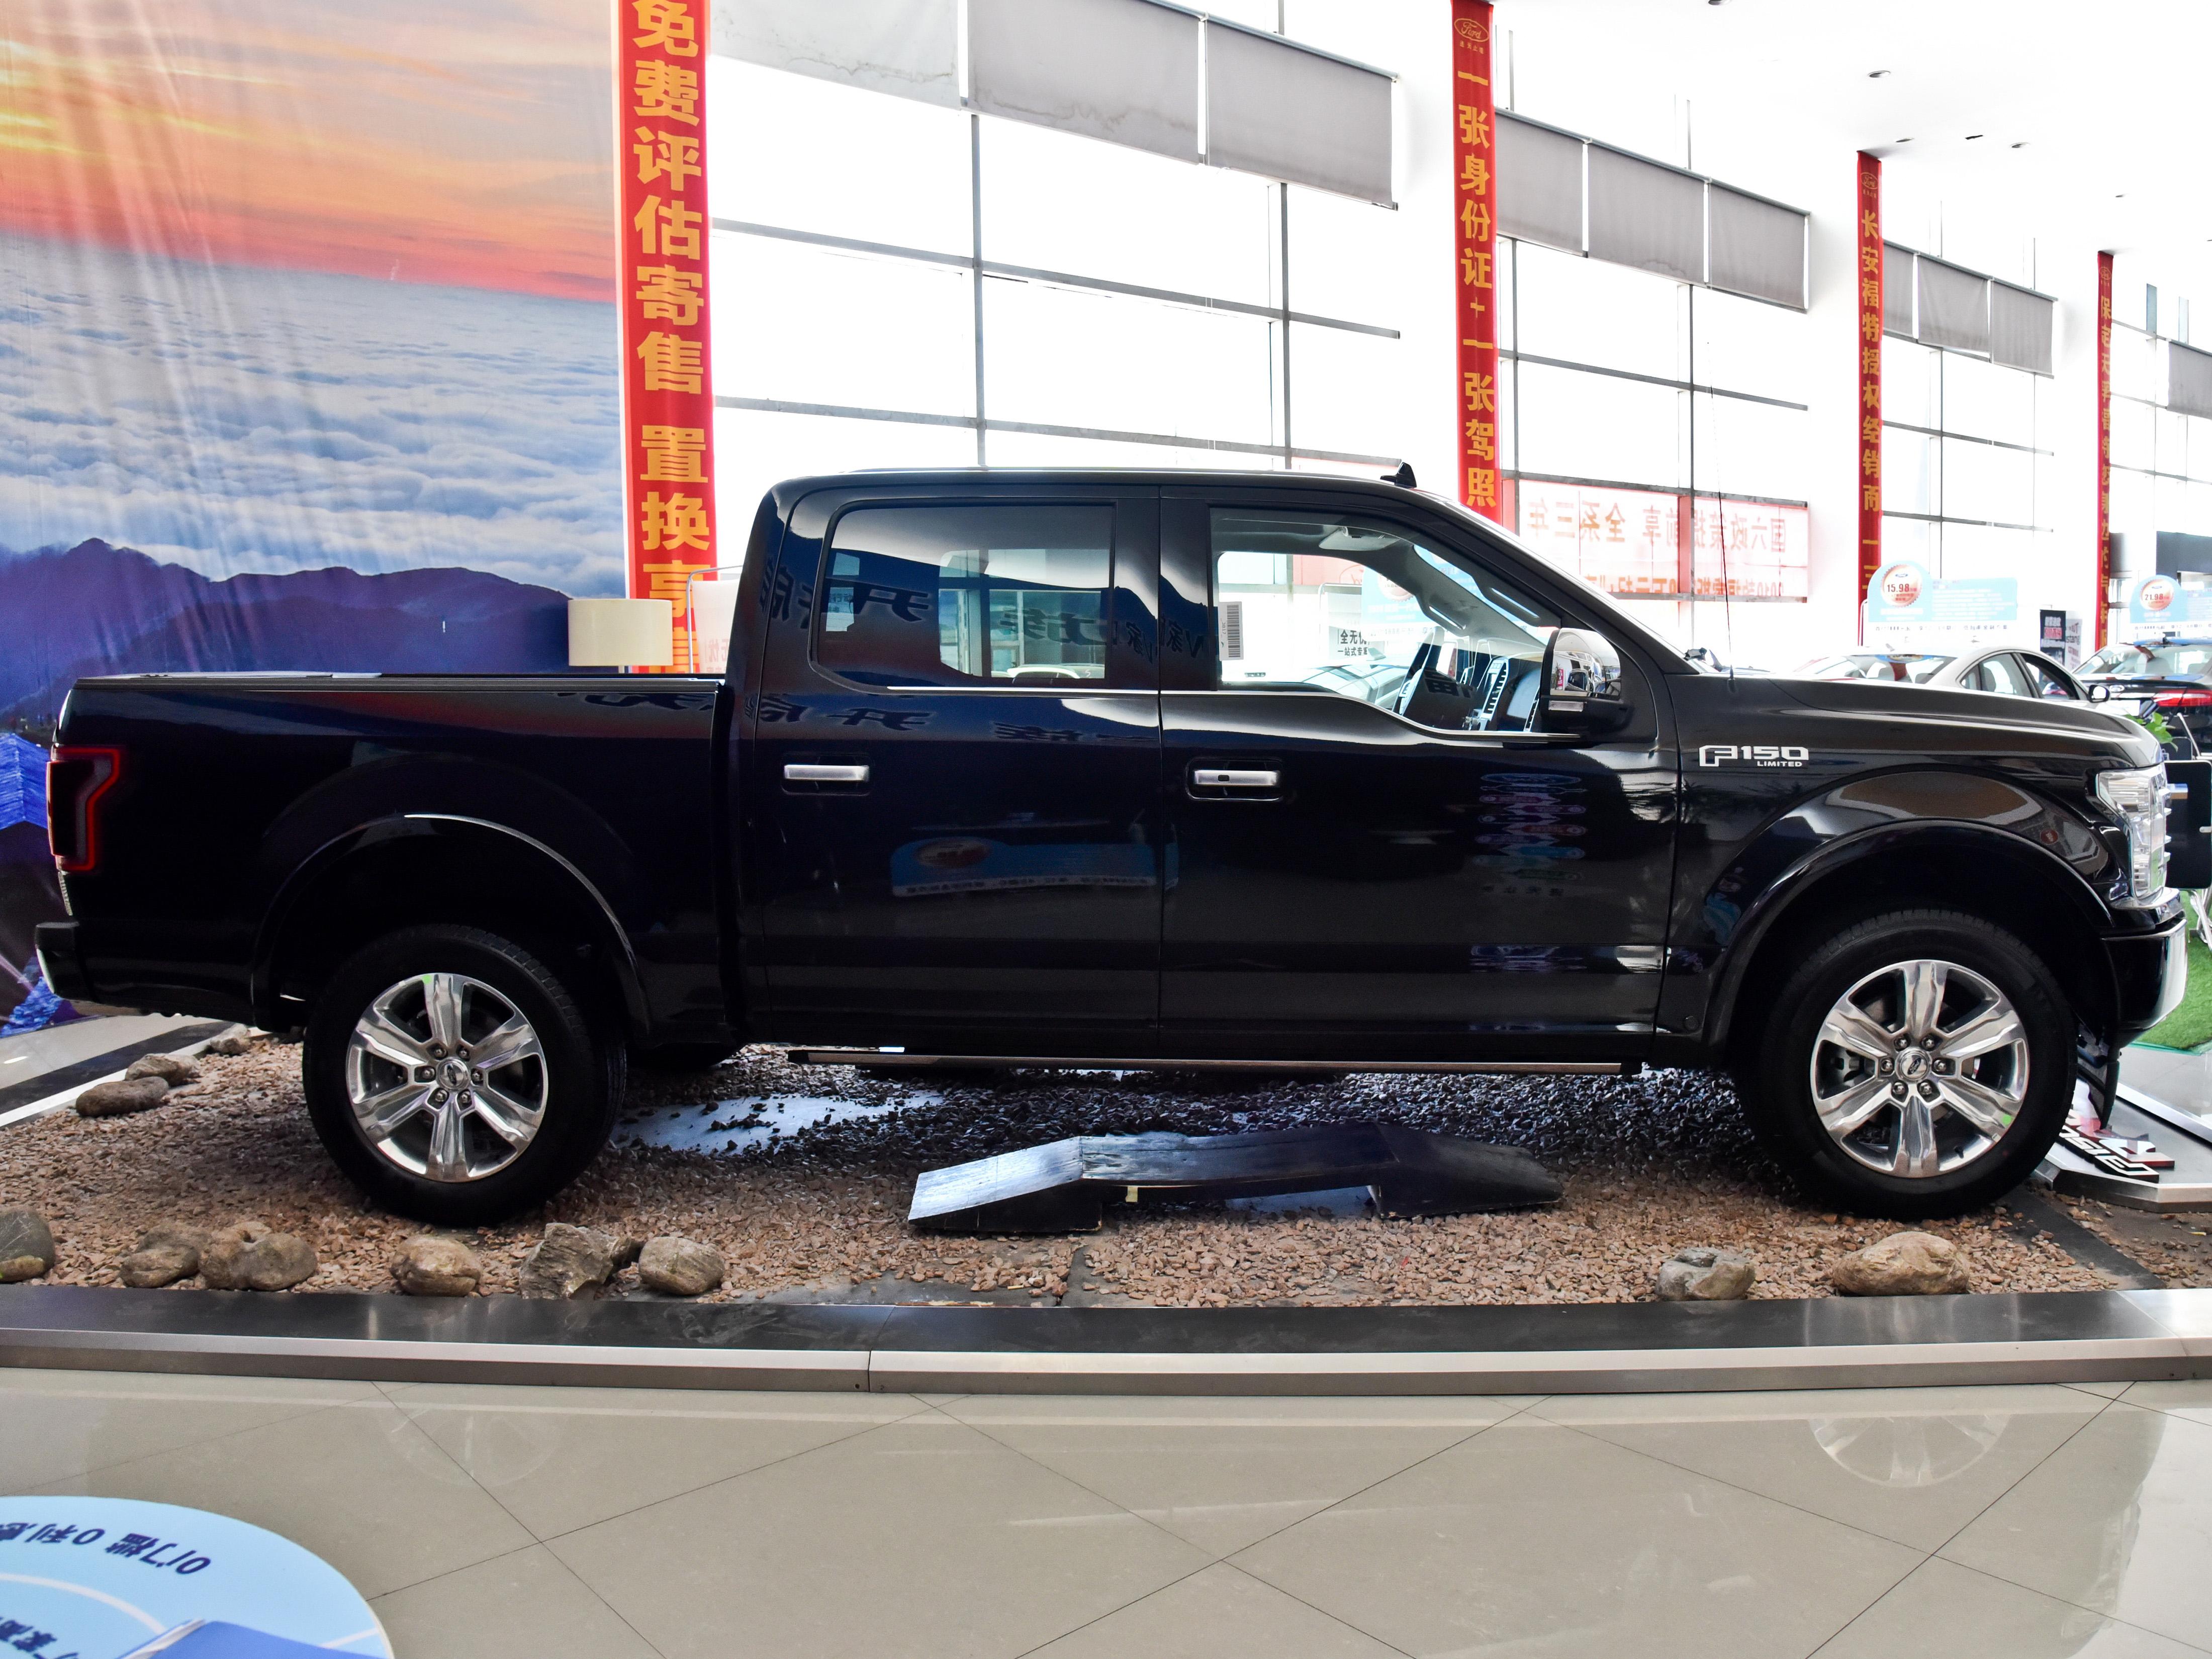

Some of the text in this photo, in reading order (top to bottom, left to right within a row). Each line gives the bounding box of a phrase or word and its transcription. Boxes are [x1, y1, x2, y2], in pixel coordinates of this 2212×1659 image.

[1461, 22, 1483, 39] Ford
[632, 0, 704, 394] 免费评估寄售
[1457, 70, 1497, 508] 一张身份证+一张驾照
[1887, 583, 1909, 592] 15.98
